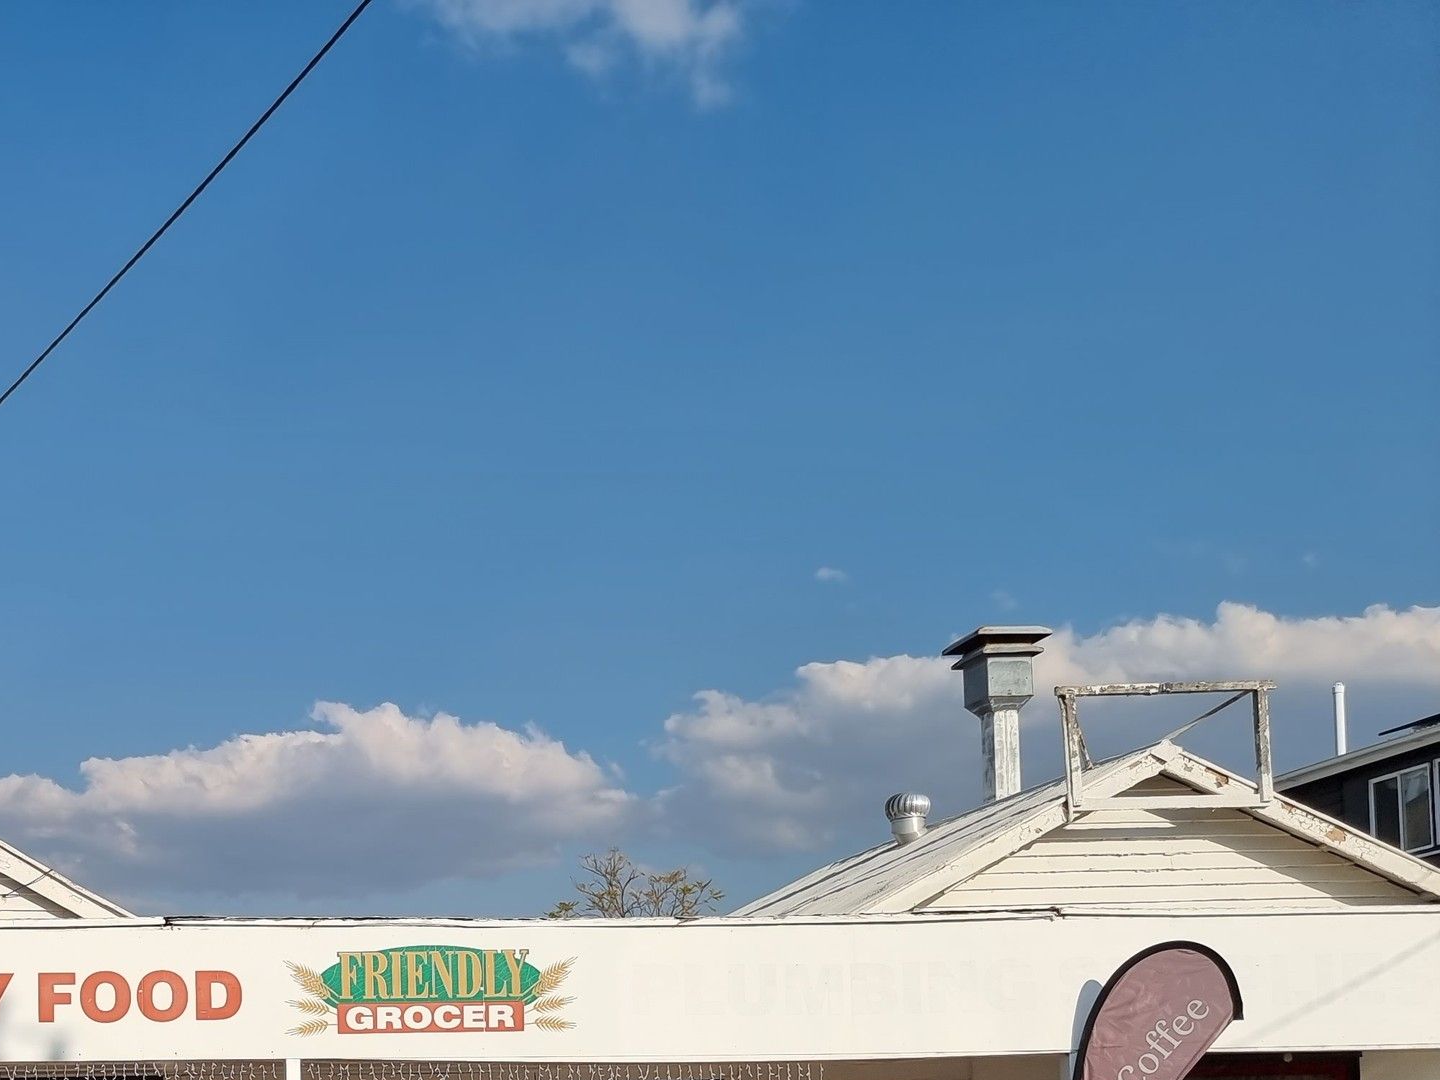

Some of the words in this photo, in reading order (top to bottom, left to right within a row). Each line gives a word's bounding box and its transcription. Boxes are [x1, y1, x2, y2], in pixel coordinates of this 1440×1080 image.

[38, 970, 243, 1024] FOOD
[337, 949, 530, 999] FRIENDLY
[345, 1004, 516, 1031] GROCER
